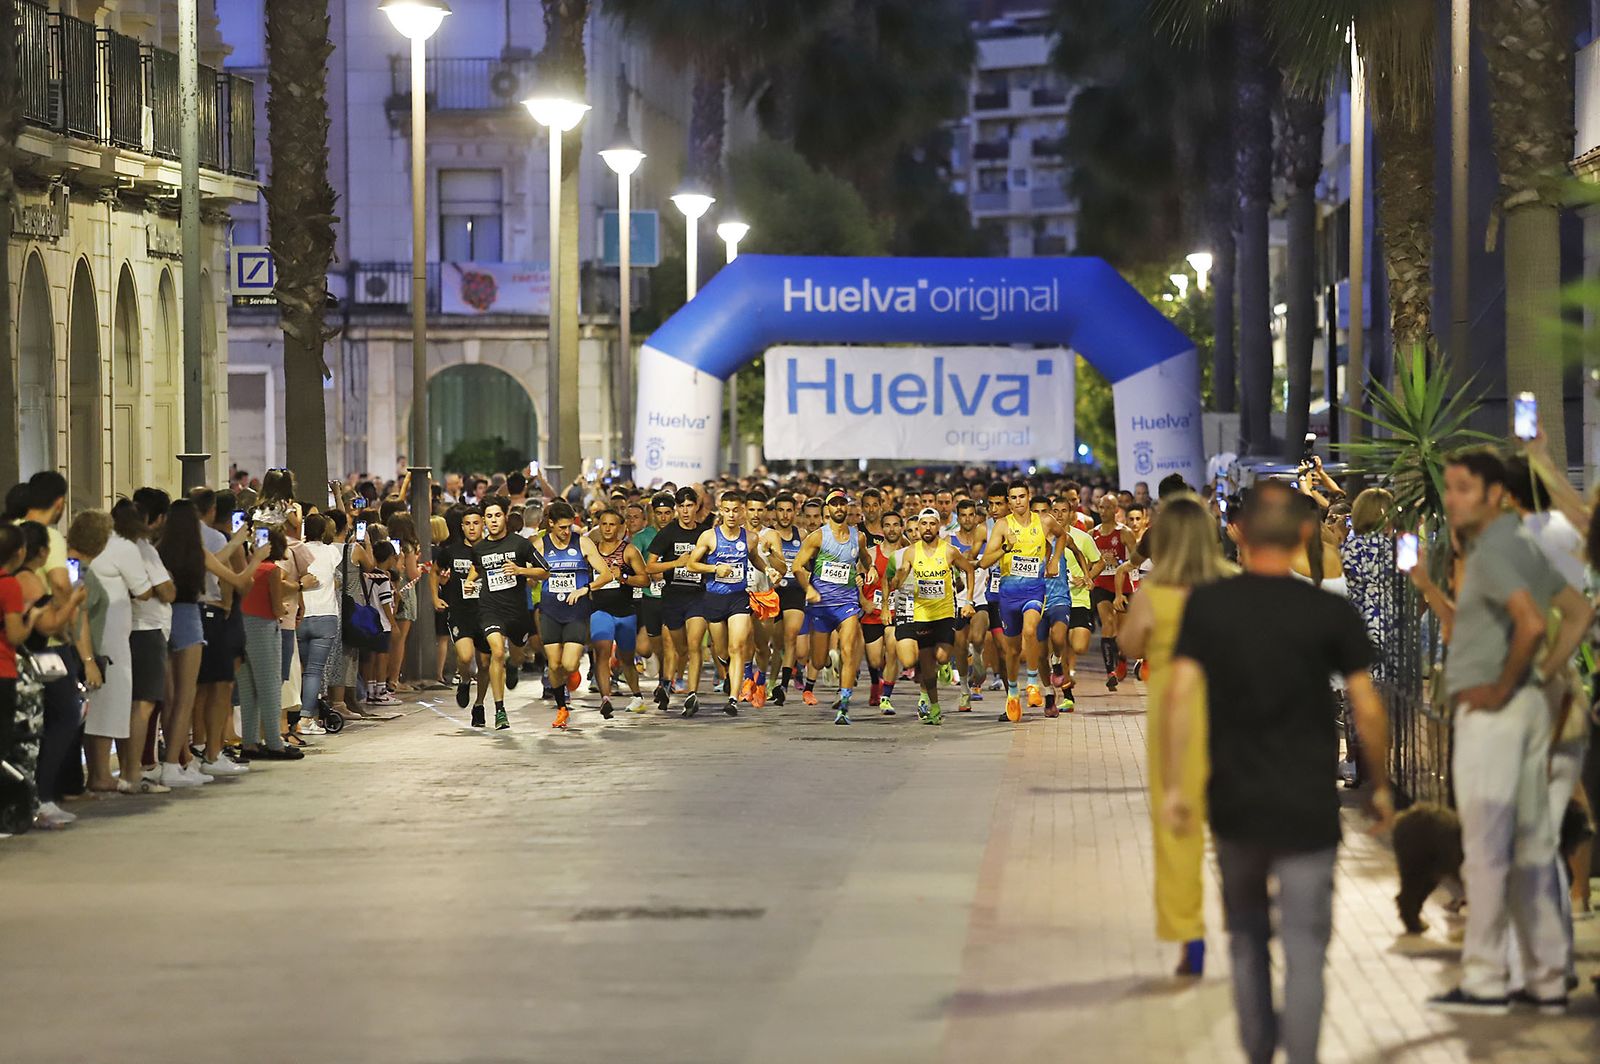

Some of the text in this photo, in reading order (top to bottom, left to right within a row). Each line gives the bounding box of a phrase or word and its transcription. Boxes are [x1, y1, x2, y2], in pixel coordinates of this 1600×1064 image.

[783, 278, 1058, 320] Huelva original
[787, 357, 1030, 417] Huelva
[648, 411, 705, 429] Huelva
[1131, 413, 1190, 430] Huelva
[944, 426, 1031, 450] original
[665, 460, 702, 469] HUELVA
[1156, 460, 1192, 469] HUELVA
[1018, 563, 1032, 572] 249
